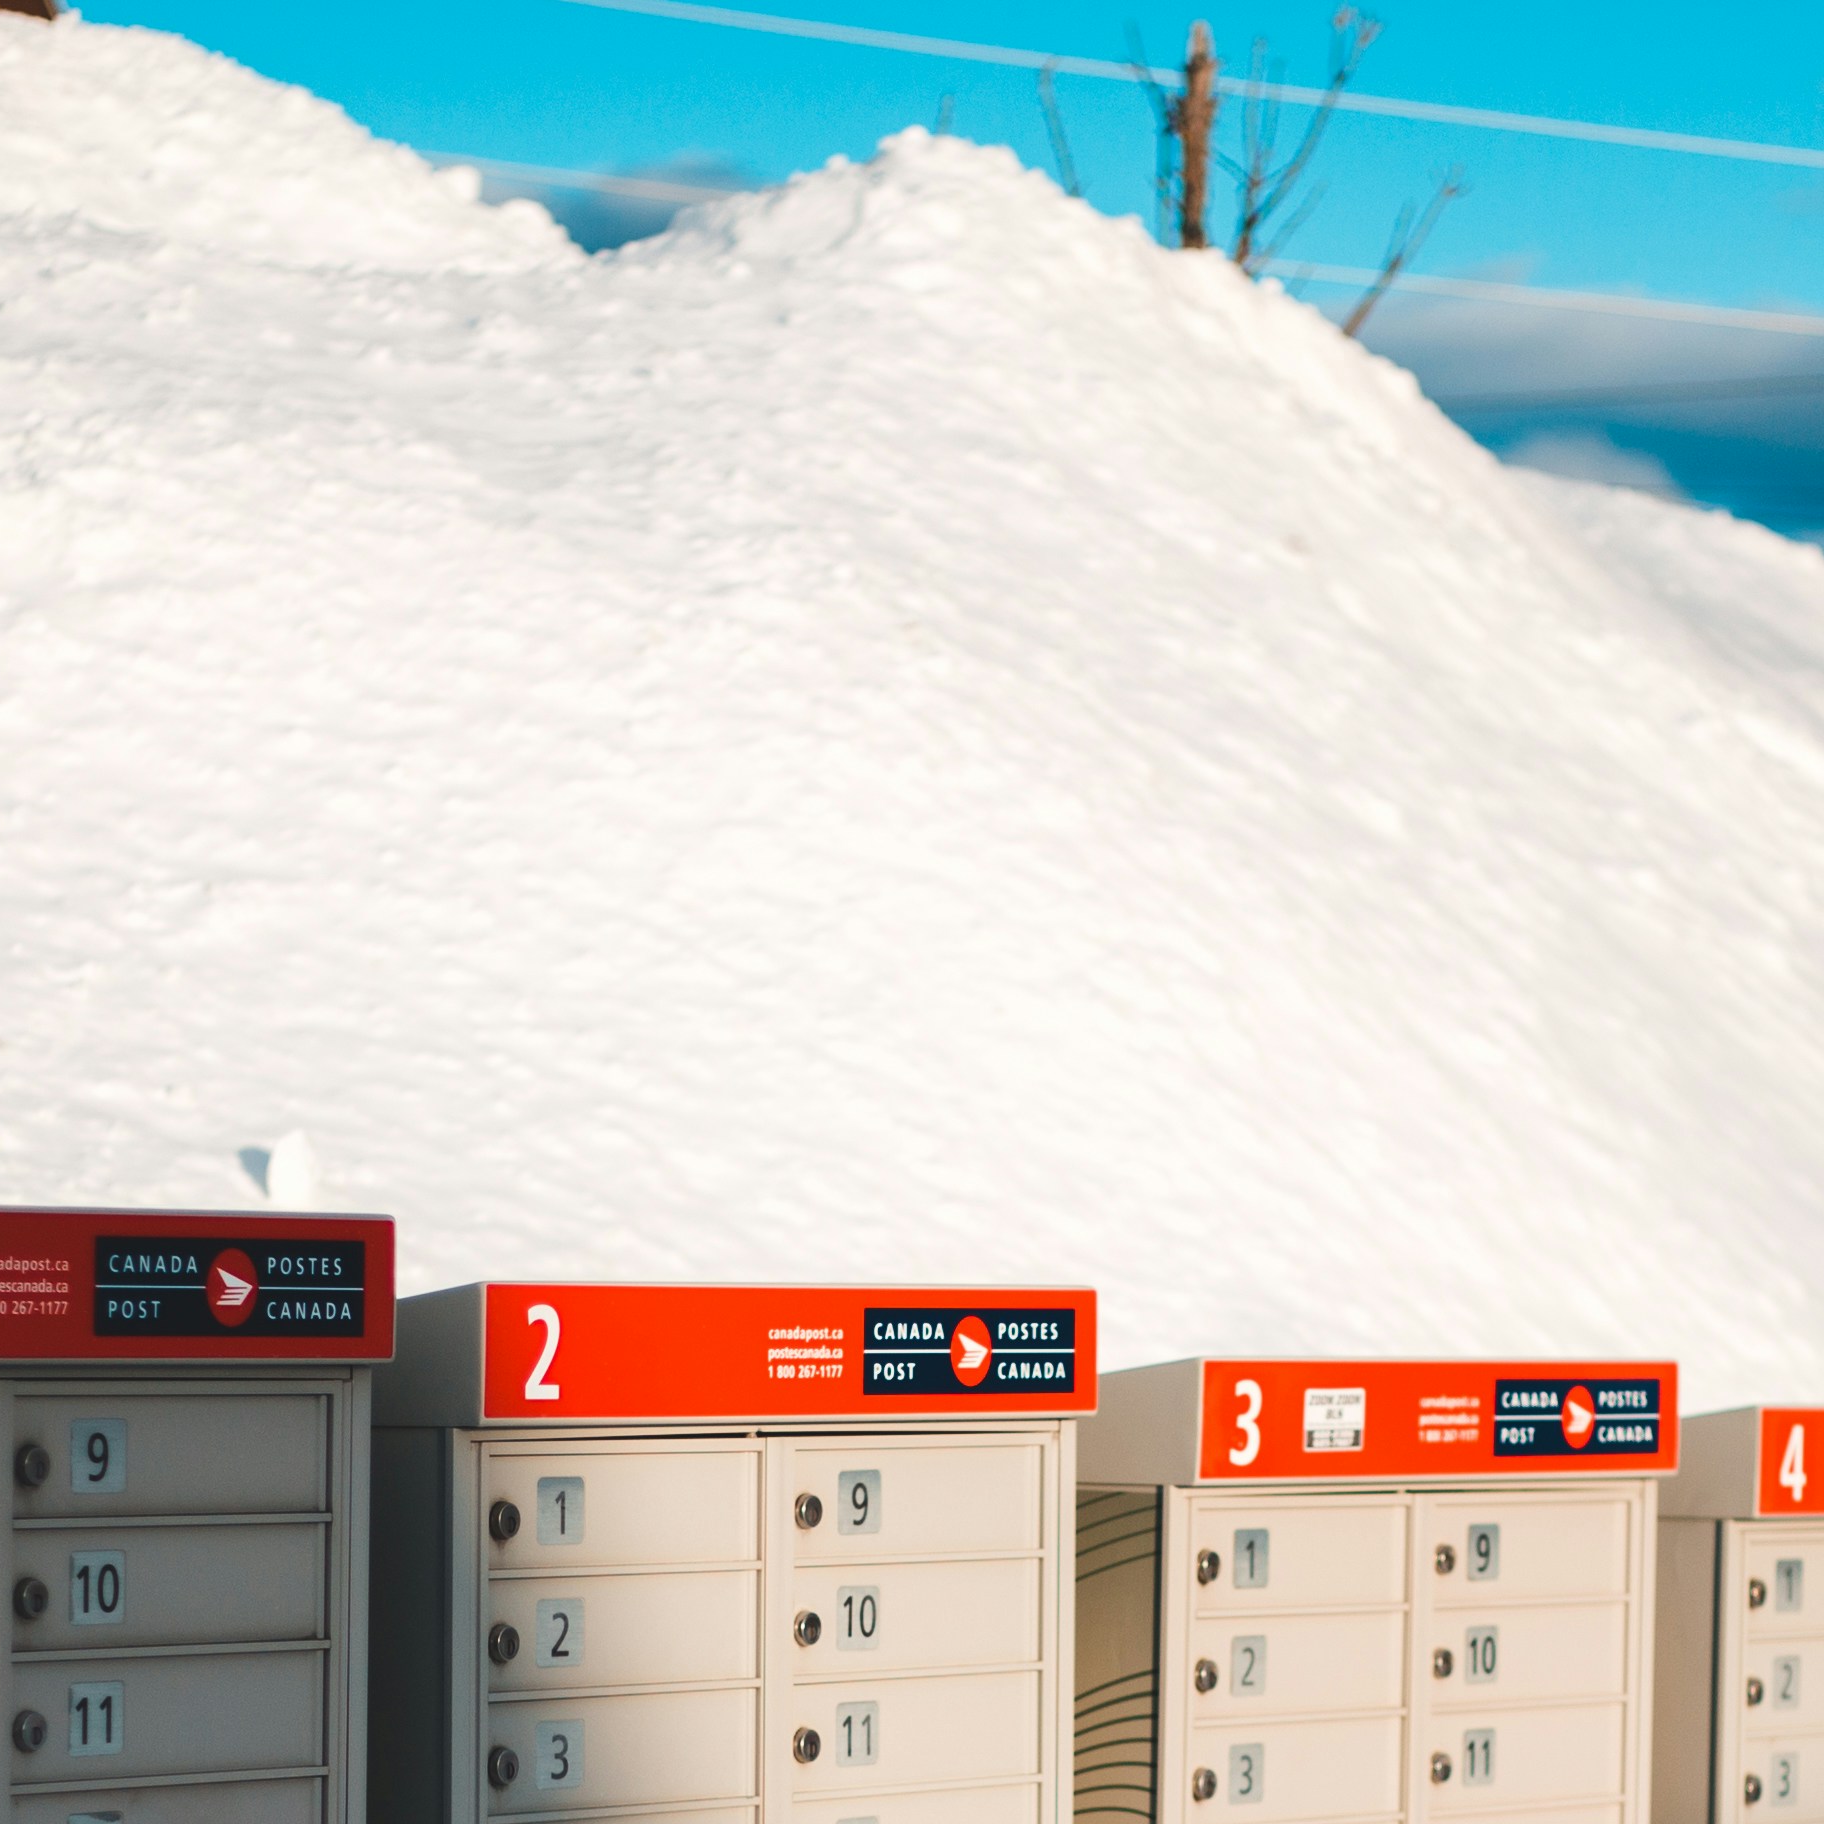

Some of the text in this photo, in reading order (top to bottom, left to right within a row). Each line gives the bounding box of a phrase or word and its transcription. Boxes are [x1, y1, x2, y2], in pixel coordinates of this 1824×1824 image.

[109, 1255, 198, 1274] CANADA
[267, 1257, 343, 1275] POSTES
[11, 1301, 68, 1314] 267-1177
[108, 1300, 161, 1318] POST
[266, 1302, 352, 1319] CANADA
[768, 1325, 844, 1343] canadapost.ca
[873, 1322, 945, 1340] CANADA
[998, 1322, 1058, 1340] POSTES
[524, 1304, 560, 1400] 2
[997, 1362, 1066, 1379] CANADA
[768, 1365, 843, 1378] 1 800 267-1177
[873, 1363, 916, 1380] POST
[1502, 1391, 1558, 1408] CANADA
[1599, 1391, 1648, 1408] POSTES
[1229, 1379, 1263, 1466] 3
[1501, 1427, 1535, 1444] POST
[1598, 1426, 1653, 1443] CANADA
[87, 1432, 109, 1482] 9
[1780, 1424, 1806, 1502] 4
[555, 1490, 567, 1535] 1
[851, 1482, 869, 1526] 9
[1246, 1540, 1255, 1578] 1
[1477, 1533, 1490, 1572] 9
[77, 1564, 119, 1613] 10
[551, 1612, 570, 1657] 2
[843, 1594, 877, 1638] 10
[1241, 1647, 1256, 1686] 2
[1470, 1636, 1496, 1674] 10
[1781, 1664, 1793, 1701] 2
[76, 1696, 114, 1744] 11
[842, 1713, 873, 1757] 11
[551, 1734, 569, 1780] 3
[1239, 1755, 1253, 1795] 3
[1468, 1740, 1491, 1777] 11
[1779, 1761, 1791, 1797] 3
